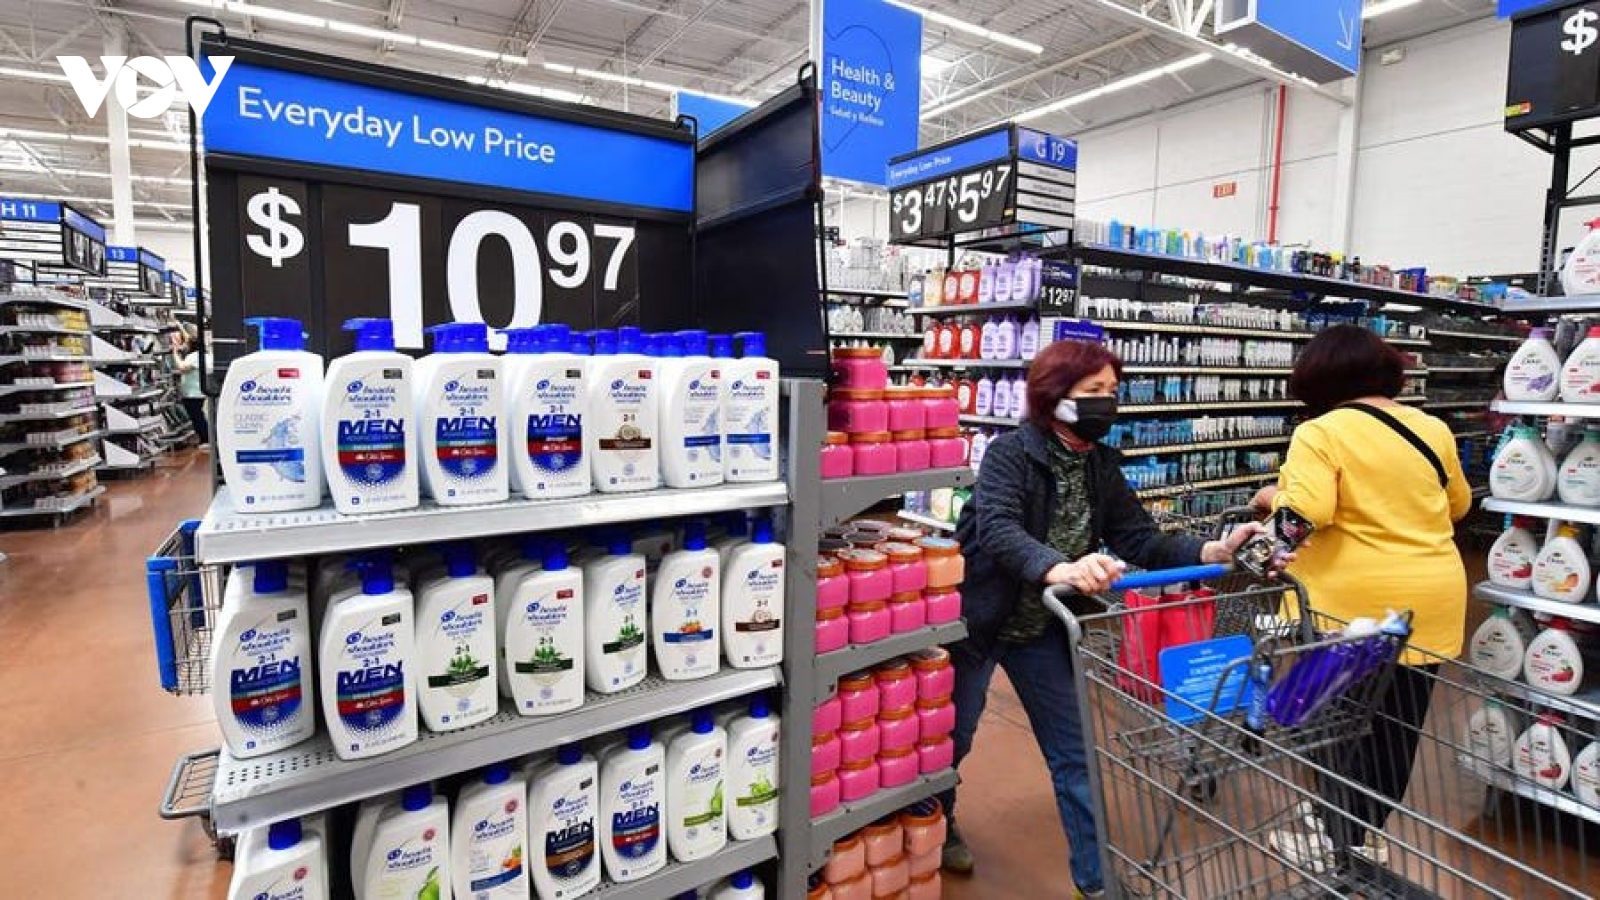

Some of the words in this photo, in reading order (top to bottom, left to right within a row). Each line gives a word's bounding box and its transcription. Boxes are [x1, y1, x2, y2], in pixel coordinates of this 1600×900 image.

[1561, 9, 1599, 55] $
[831, 57, 880, 87] Health
[884, 72, 895, 91] &
[831, 80, 881, 112] Beauty
[238, 86, 402, 147] Everyday
[413, 115, 475, 150] Low
[484, 128, 556, 163] Price
[1037, 141, 1046, 158] G
[1051, 142, 1066, 161] 19
[1, 202, 17, 216] H
[22, 203, 37, 218] 11
[338, 418, 404, 435] MEN
[437, 416, 496, 431] MEN
[528, 414, 582, 428] MEN
[231, 656, 300, 682] MEN
[337, 660, 402, 685] MEN
[613, 802, 658, 824] MEN
[546, 817, 594, 842] MEN
